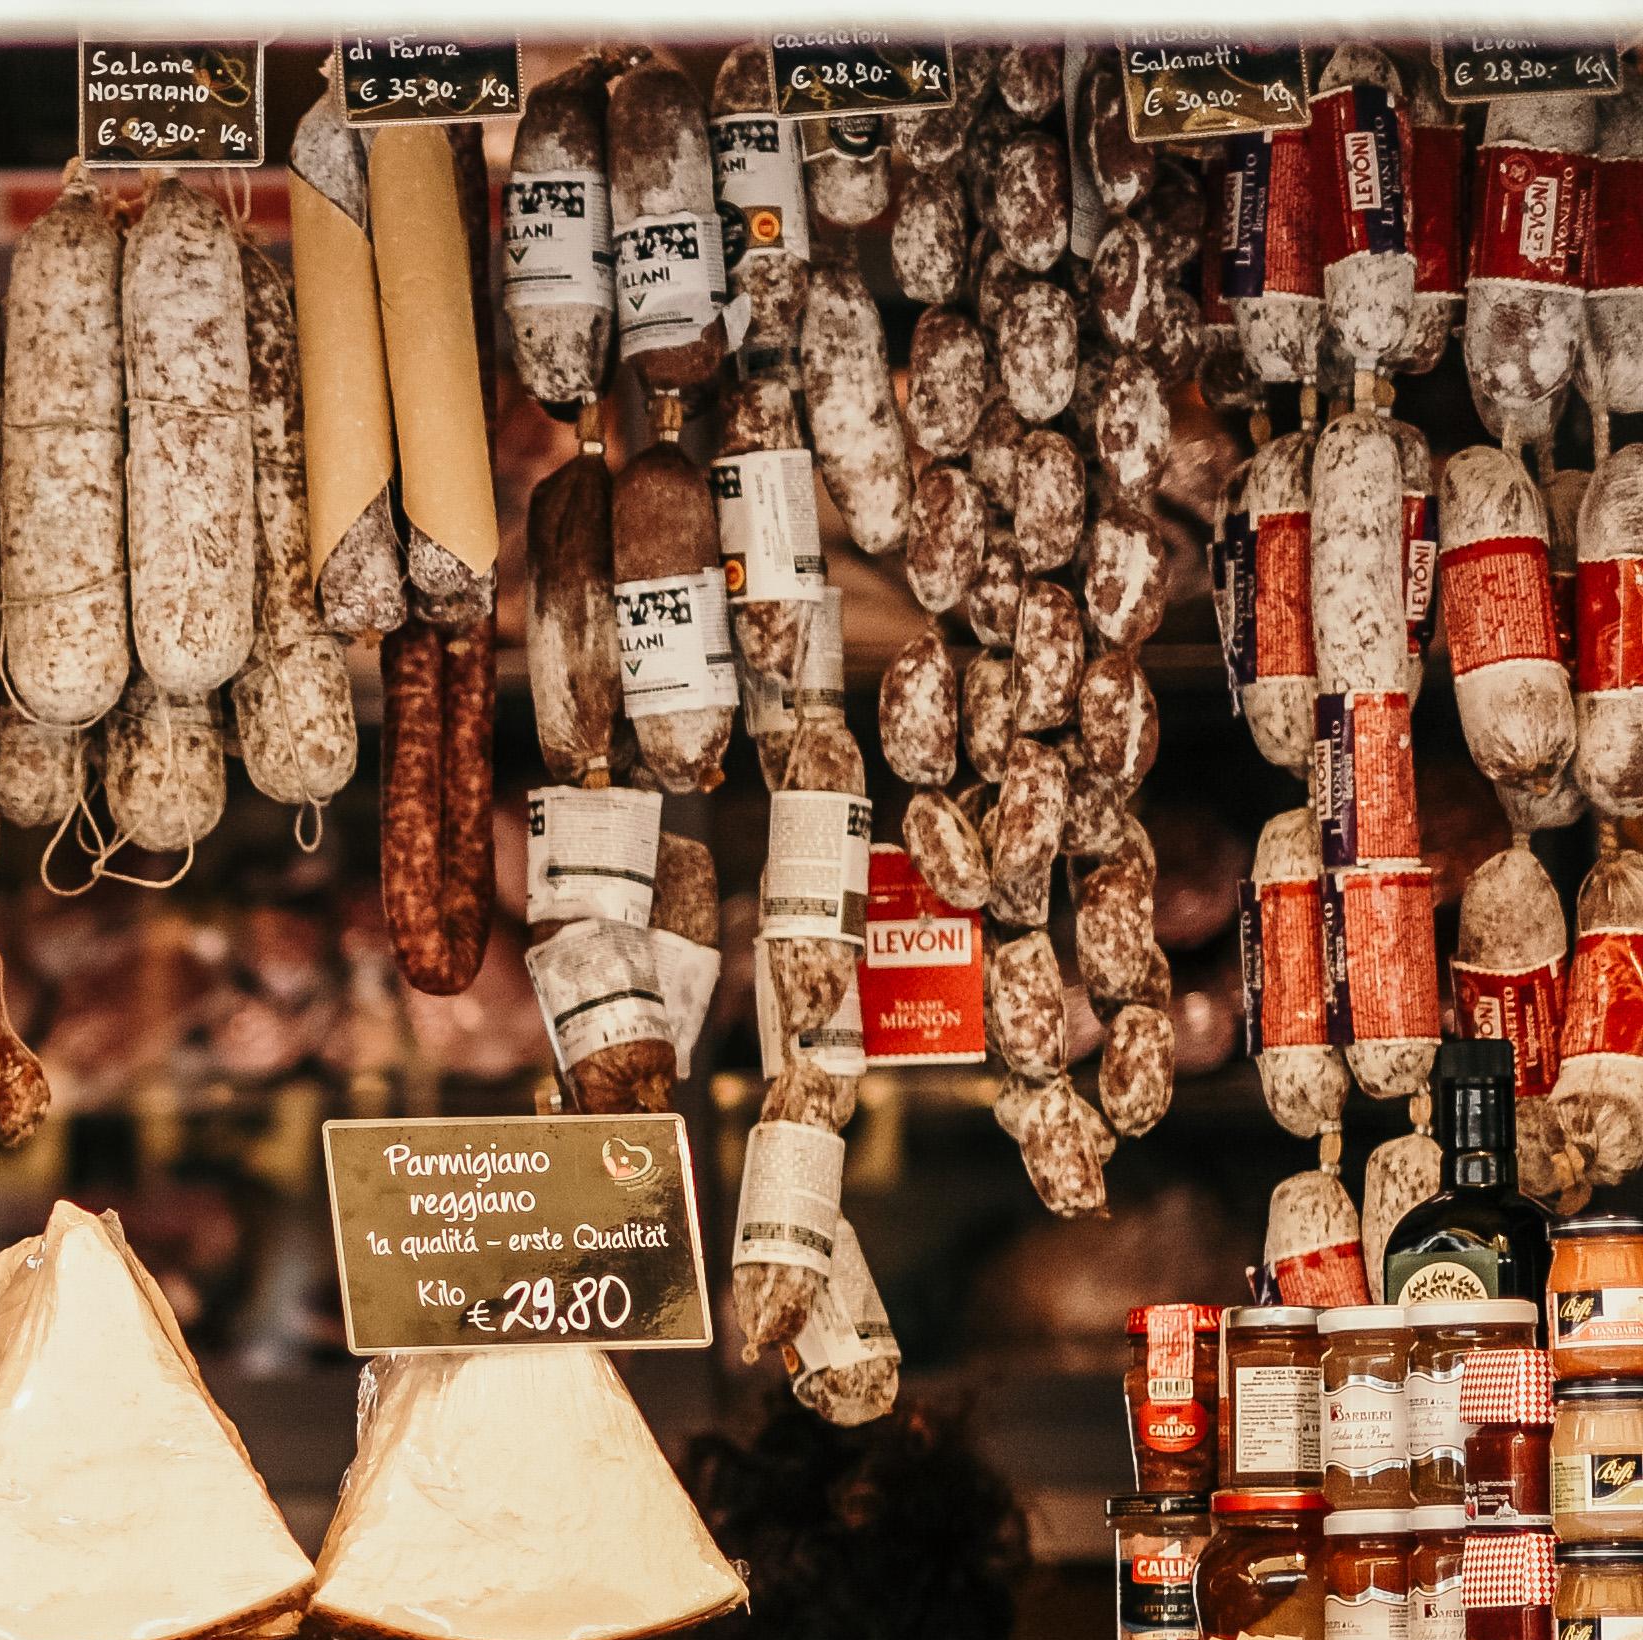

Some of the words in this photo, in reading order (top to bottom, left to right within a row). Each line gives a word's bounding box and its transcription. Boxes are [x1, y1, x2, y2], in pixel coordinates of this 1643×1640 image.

[92, 50, 195, 75] Salame
[349, 41, 373, 60] di
[390, 37, 460, 59] Parma
[1131, 45, 1240, 73] Salametti
[88, 82, 209, 103] NOSTRANO
[1351, 135, 1372, 205] LEVONI
[1410, 543, 1435, 619] LEVONI
[873, 928, 963, 953] LEVONI
[880, 1009, 962, 1029] MIGNON
[383, 1142, 551, 1183] Parmigiano
[410, 1182, 536, 1222] reggiano
[508, 1228, 564, 1251] erste
[573, 1224, 670, 1253] Qualität
[417, 1280, 466, 1307] Kilo
[467, 1299, 496, 1332] €
[1560, 1296, 1594, 1323] Biffi
[1149, 1423, 1195, 1437] CALLIPO
[1595, 1457, 1636, 1486] Biffi
